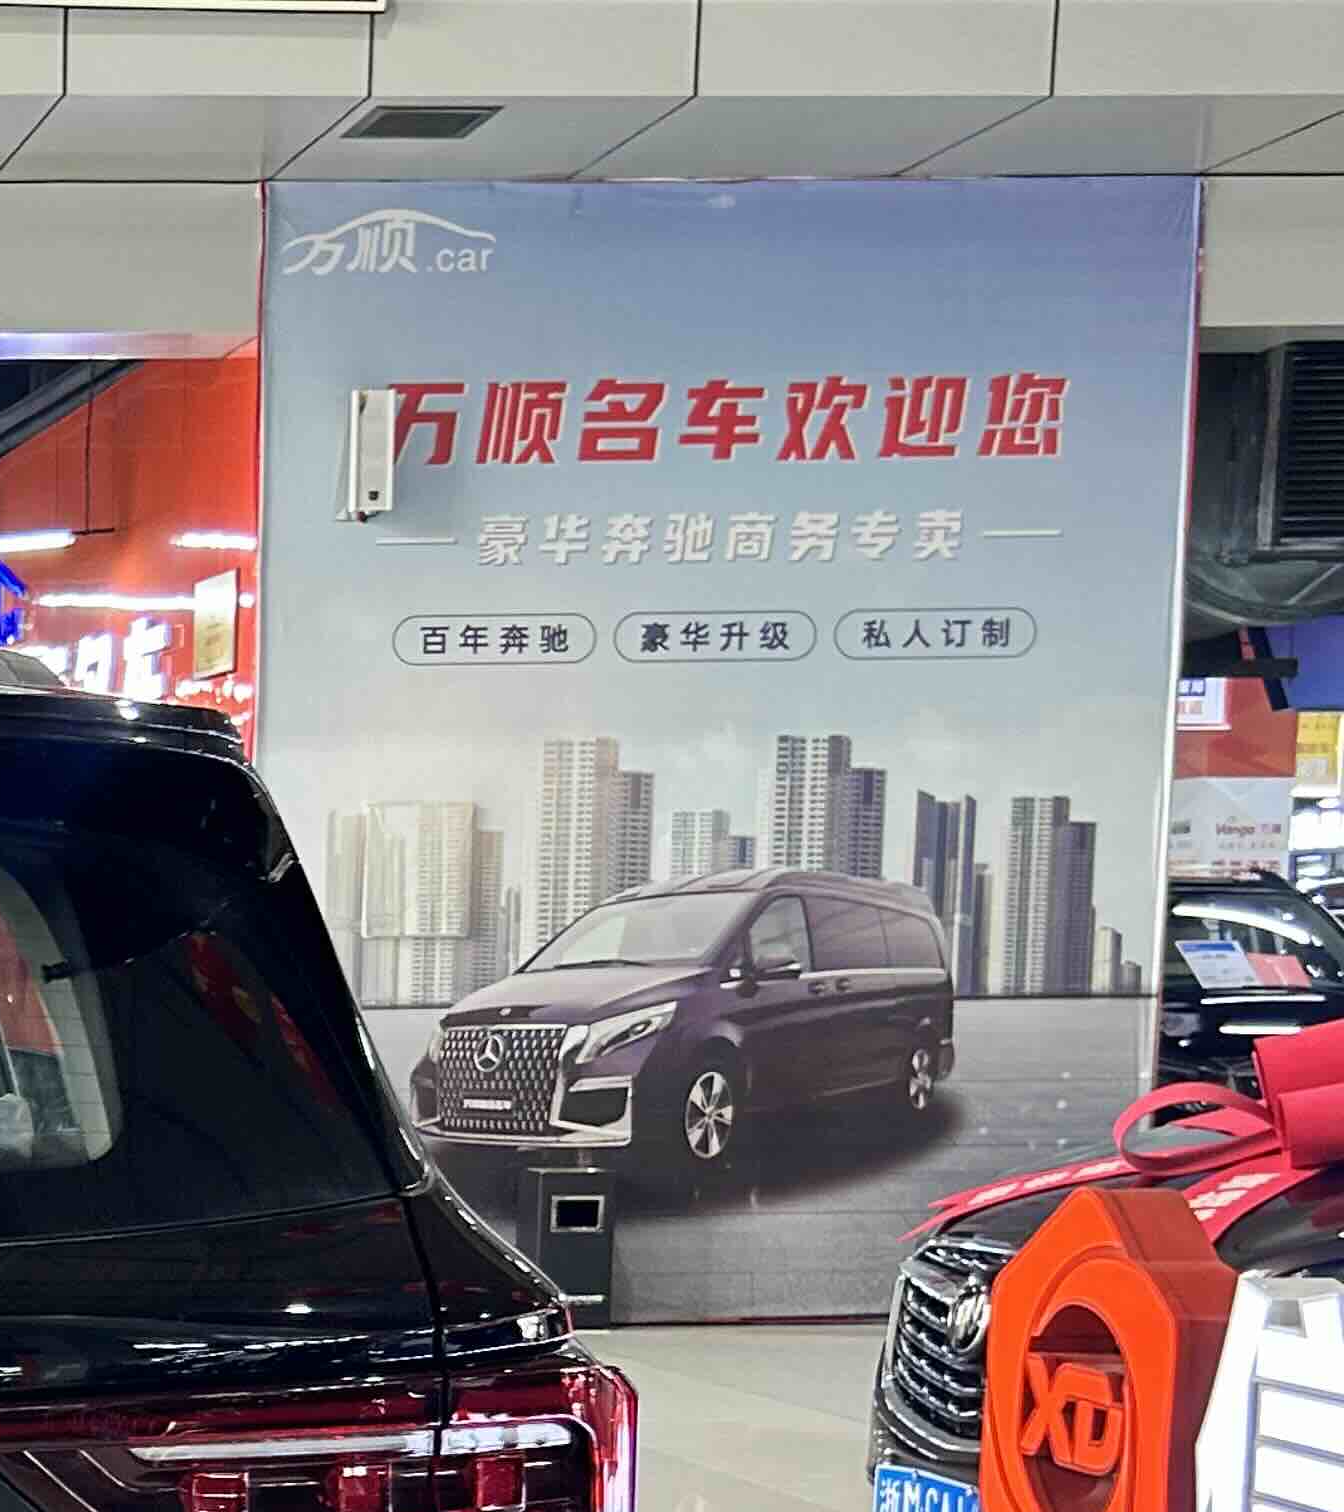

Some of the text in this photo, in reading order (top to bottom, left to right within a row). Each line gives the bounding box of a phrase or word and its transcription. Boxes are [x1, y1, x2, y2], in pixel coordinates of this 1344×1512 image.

[393, 373, 1070, 466] 万顺名车欢迎您
[478, 508, 965, 567] 豪华奔驰商务专卖
[419, 623, 571, 655] 百年奔驰
[640, 620, 792, 653] 豪华升级
[861, 617, 1013, 650] 私人订制
